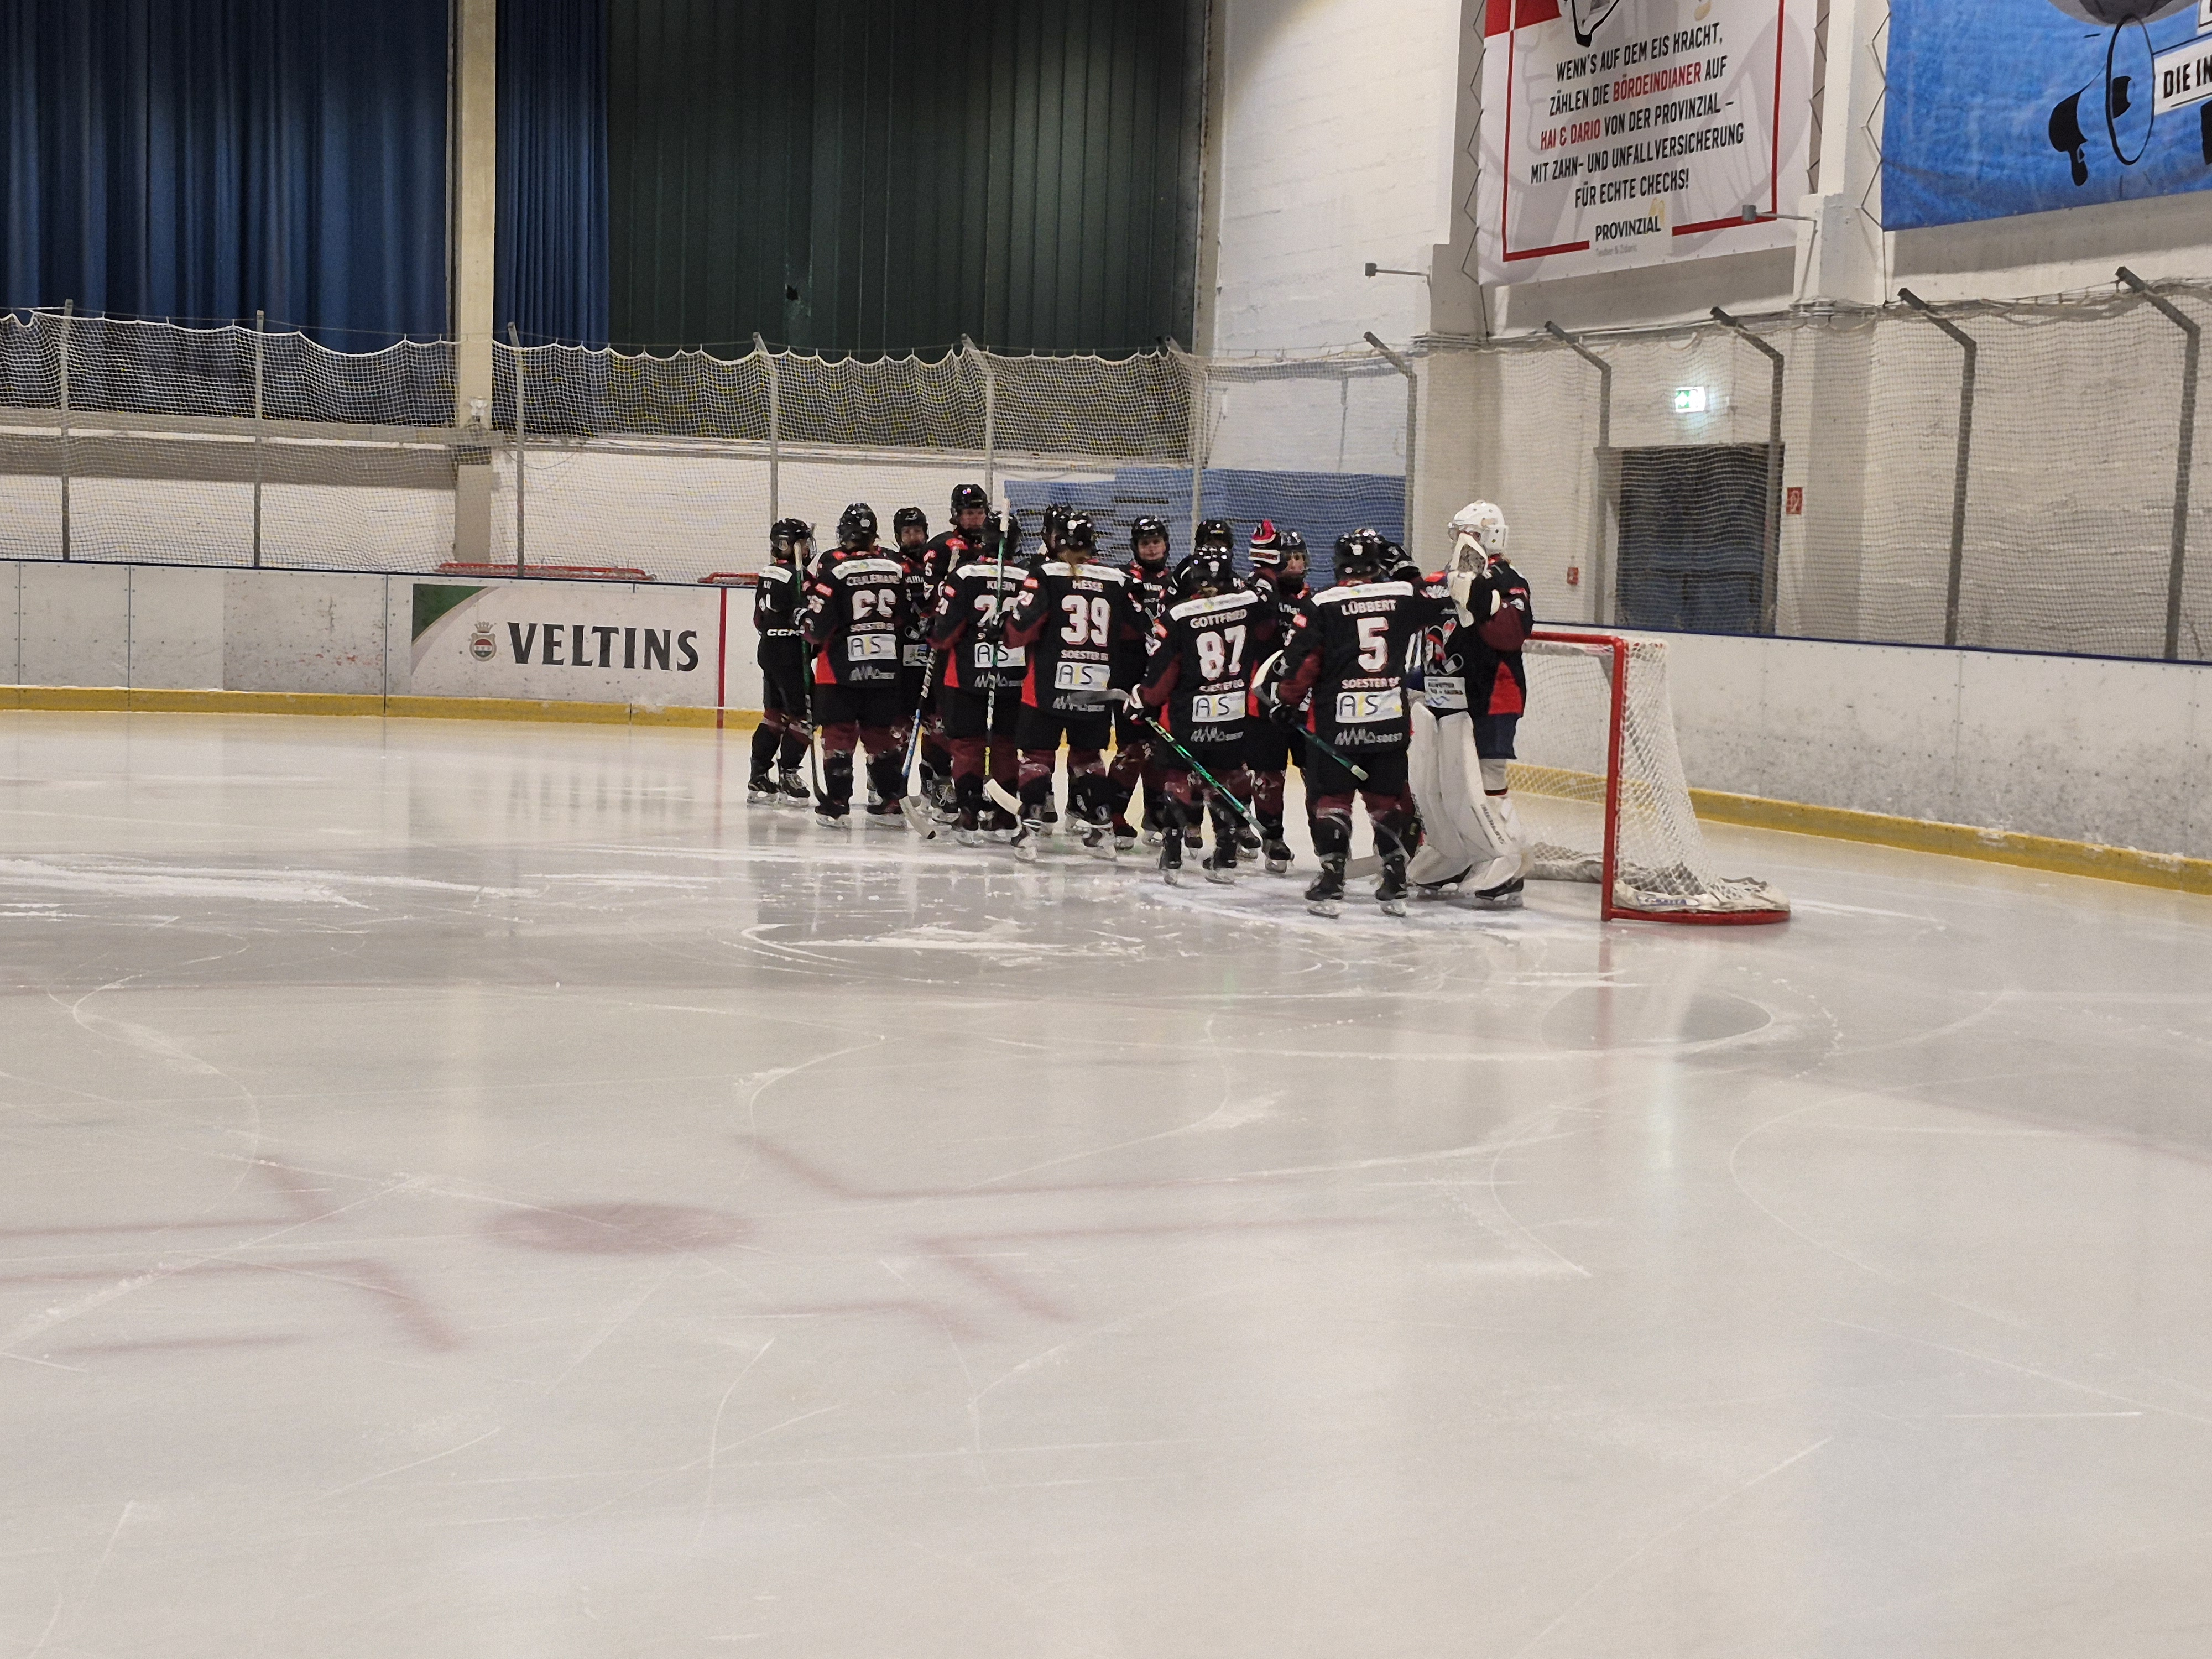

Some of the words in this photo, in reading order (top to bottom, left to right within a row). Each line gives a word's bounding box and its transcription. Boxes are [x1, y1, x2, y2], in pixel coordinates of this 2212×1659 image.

[1556, 53, 1597, 82] WENN'S
[1600, 48, 1620, 72] AUF
[1624, 41, 1647, 66] DEM
[1651, 35, 1670, 59] EIS
[1673, 22, 1723, 54] KRACHT,
[1549, 89, 1589, 117] ZÄHLEN
[1592, 83, 1610, 107] DIE
[1613, 61, 1702, 102] BÖRDEINDIANER
[1704, 55, 1728, 81] AUF
[2163, 62, 2190, 99] DIE
[1540, 128, 1556, 150] KAI
[1559, 127, 1567, 147] &
[1571, 119, 1600, 144] DARIO
[1604, 113, 1625, 137] VON
[1629, 107, 1651, 132] DER
[1654, 92, 1721, 126] PROVINZIAL
[1530, 161, 1550, 185] MIT
[1552, 155, 1584, 180] ZAHN-
[1587, 150, 1608, 174] UND
[1612, 122, 1744, 169] UNFALLVERSICHERUNG
[1574, 181, 1596, 208] FÜR
[1599, 178, 1636, 204] ECHTE
[1639, 168, 1689, 197] CHECKS!
[1595, 215, 1661, 242] PROVINZIAL
[1060, 594, 1111, 648] 39
[1190, 609, 1248, 629] GOTTFRIED
[1340, 599, 1397, 615] LÜBBERT
[507, 622, 699, 672] VELTINS
[1196, 624, 1247, 681] 87
[1356, 617, 1390, 673] 5
